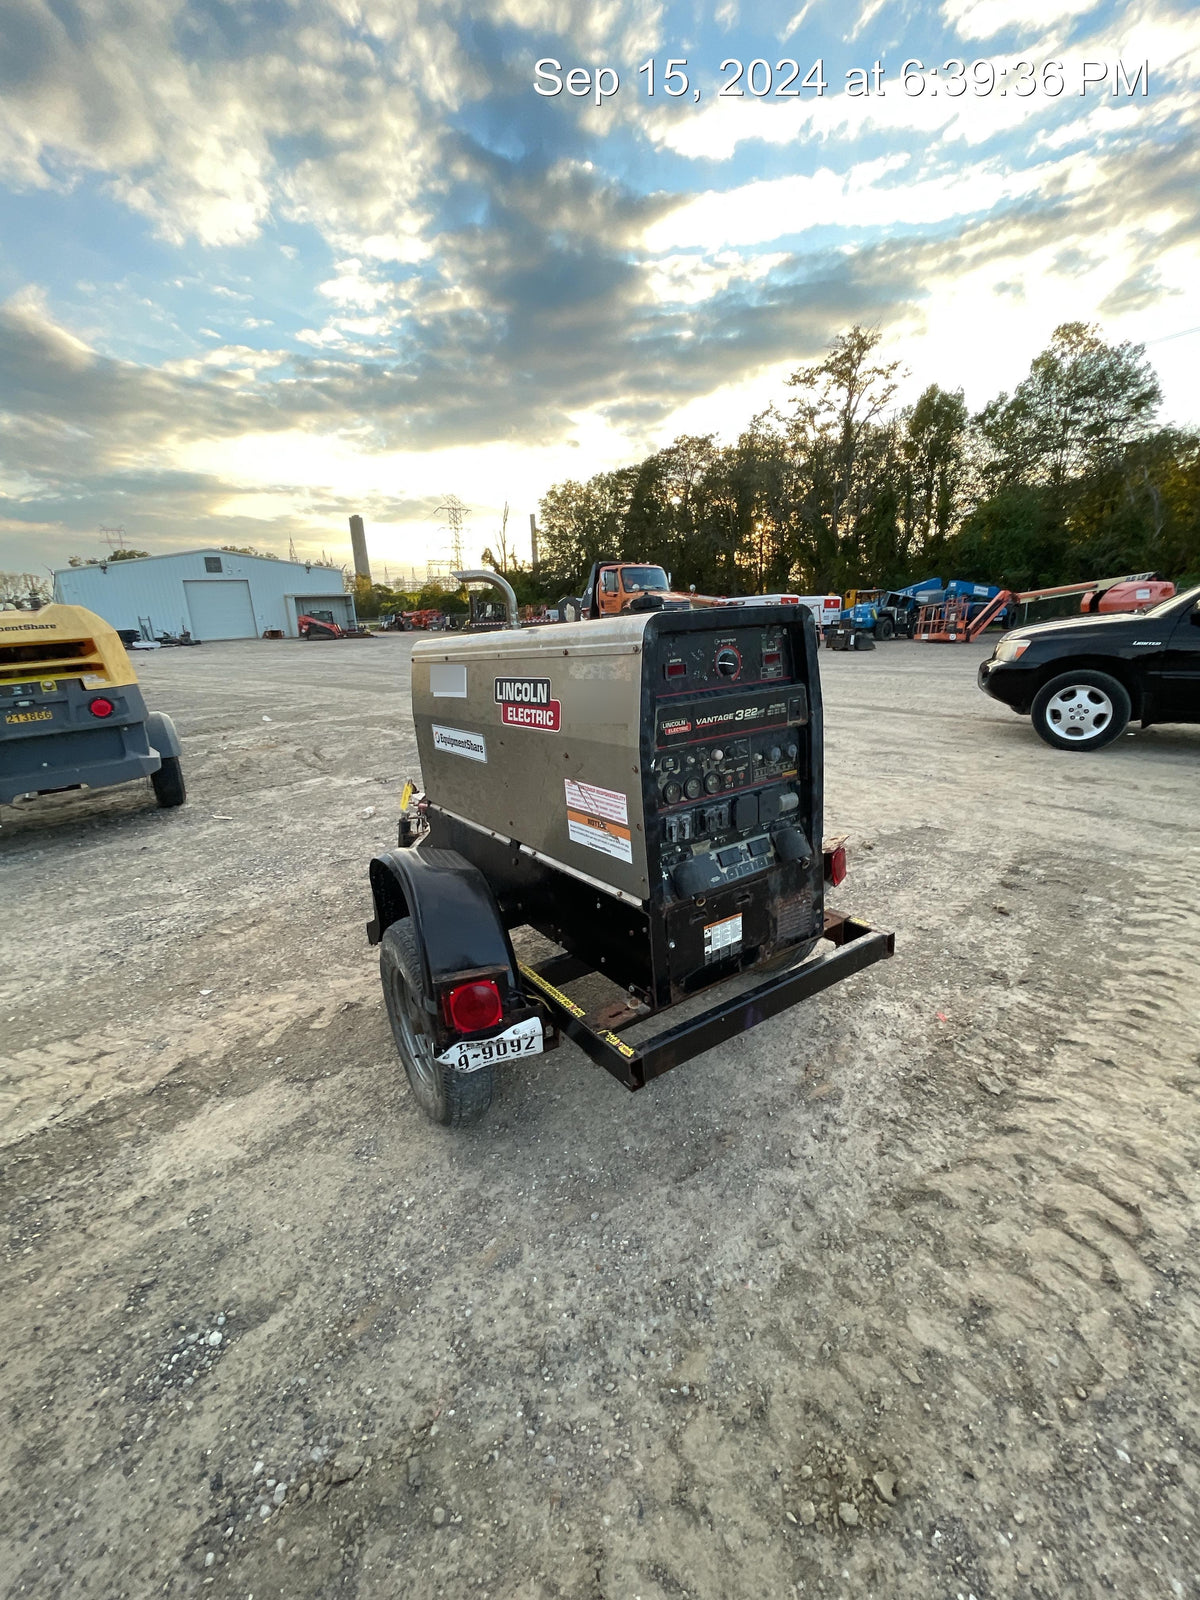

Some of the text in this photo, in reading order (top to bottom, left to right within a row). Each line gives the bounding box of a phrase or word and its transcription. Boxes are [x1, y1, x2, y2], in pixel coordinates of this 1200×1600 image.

[497, 682, 548, 703] LINCOLN
[7, 711, 51, 723] 213866
[507, 706, 554, 726] ELECTRIC
[662, 719, 686, 729] LINCOLN
[696, 713, 735, 725] VANTAGE
[734, 707, 759, 721] 322
[440, 733, 484, 753] EquipmentShare
